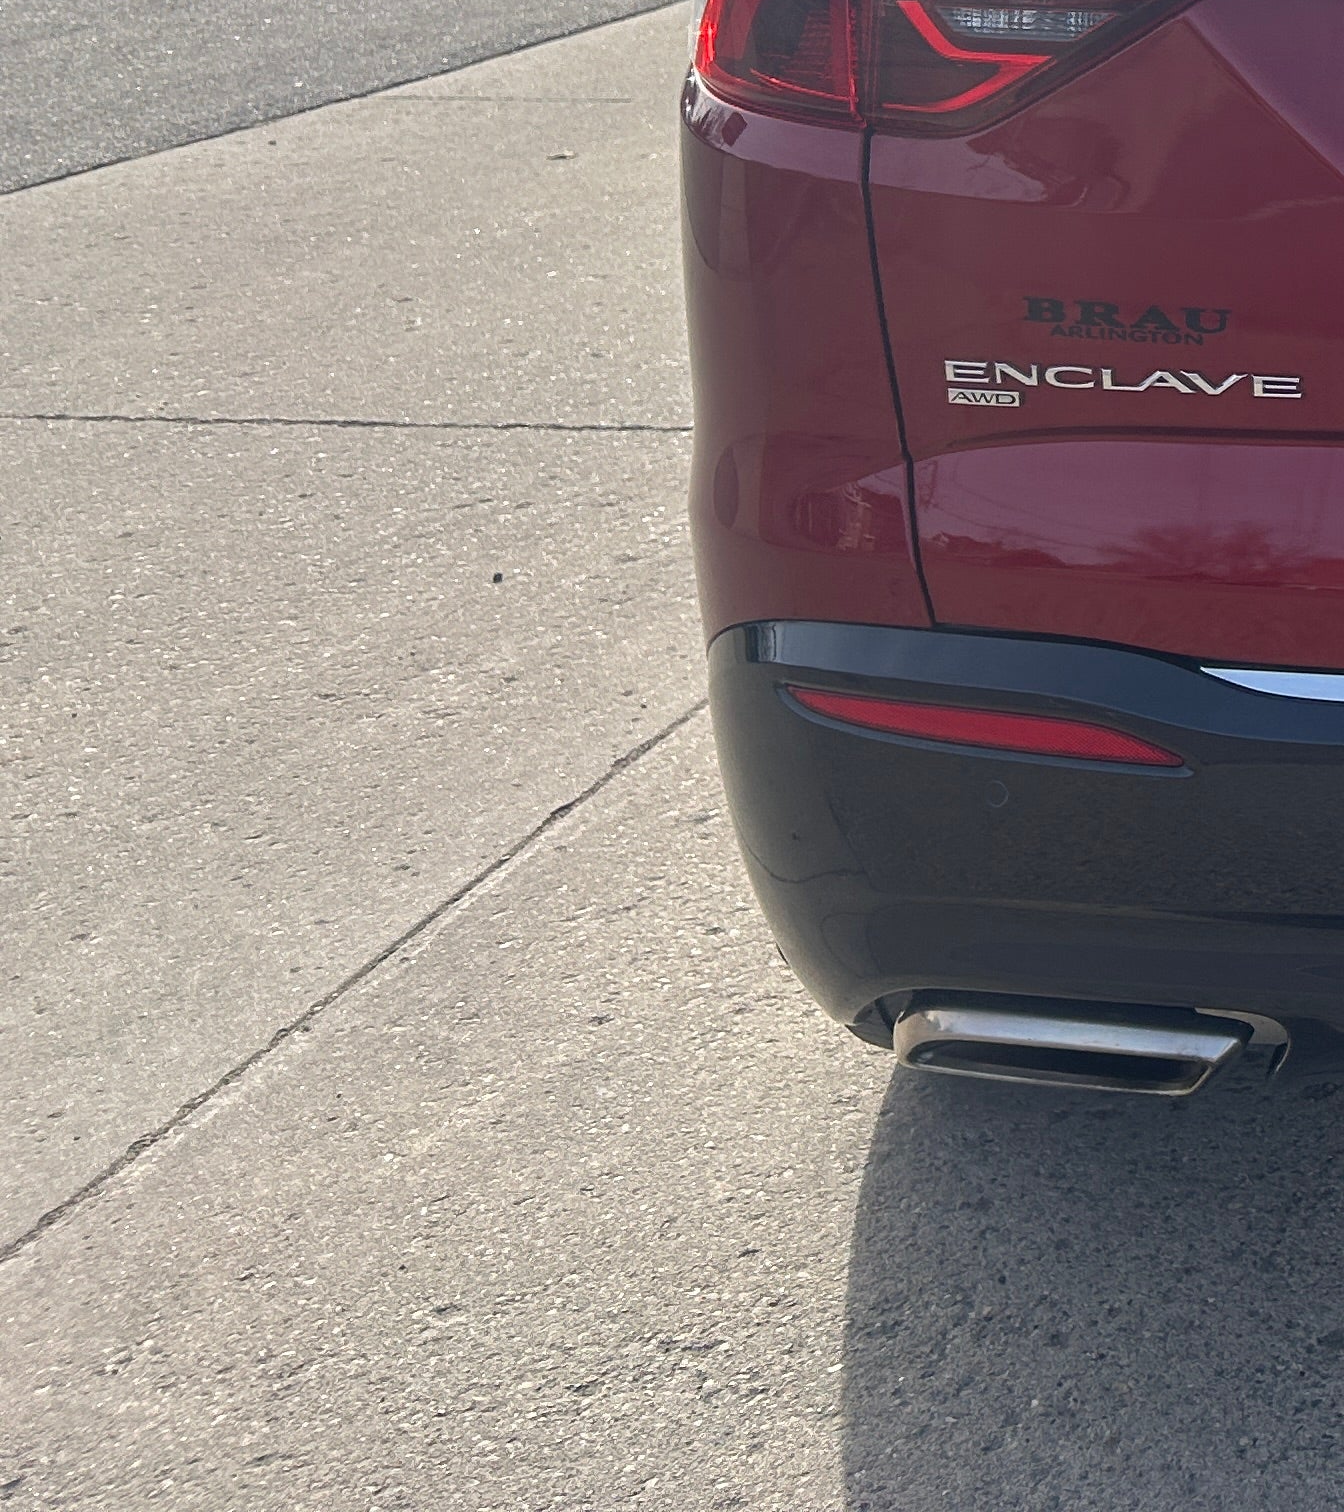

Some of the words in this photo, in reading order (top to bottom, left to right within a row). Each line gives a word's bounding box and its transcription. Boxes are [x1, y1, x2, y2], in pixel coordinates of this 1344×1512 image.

[1022, 296, 1232, 335] BRAU
[1050, 323, 1204, 346] ARLINGTON
[944, 360, 1302, 399] ENCLAVE
[949, 390, 1017, 406] AWD
